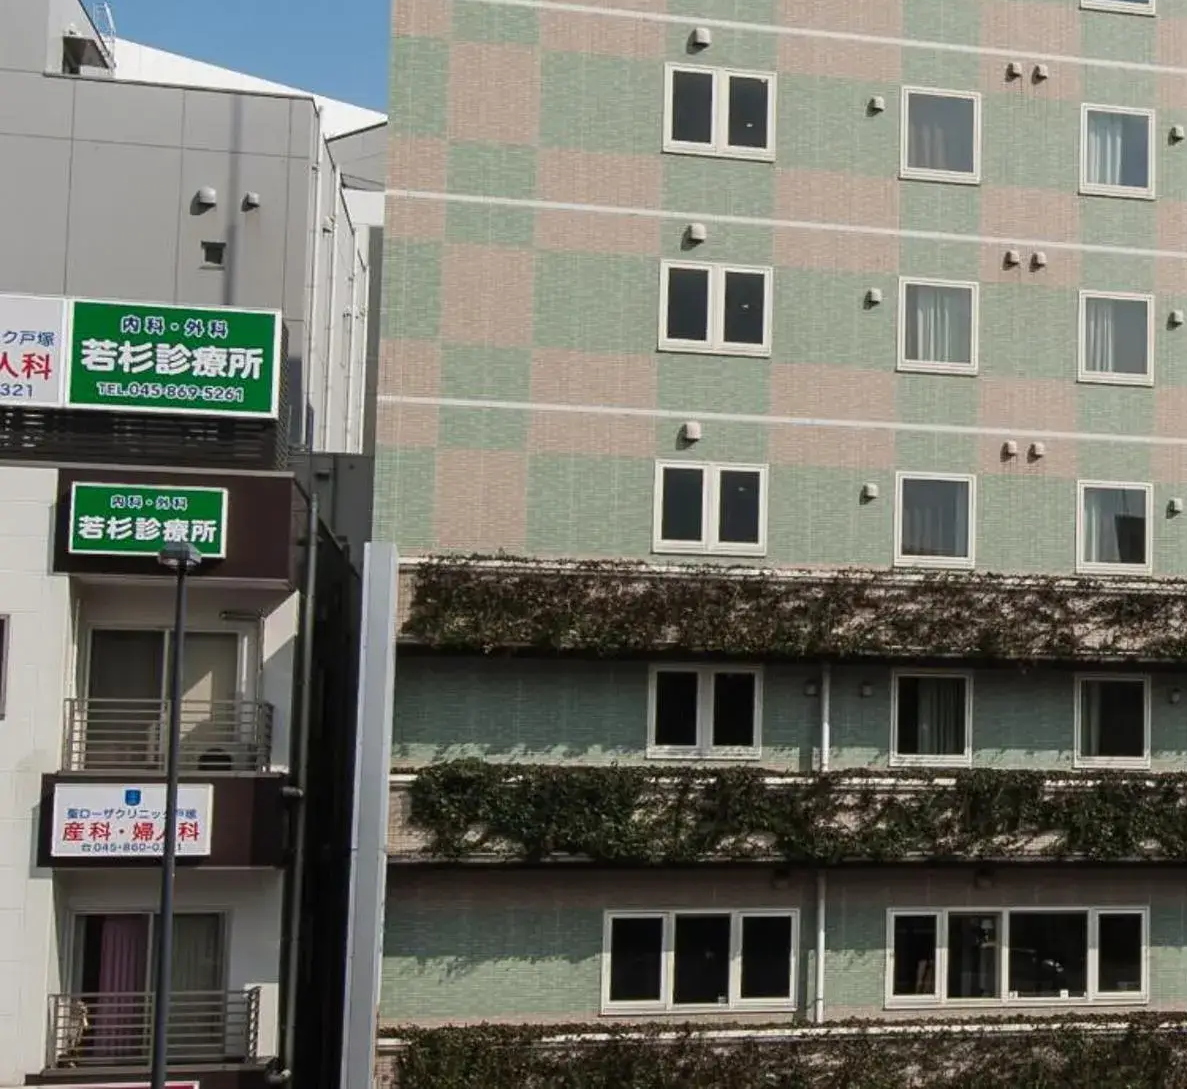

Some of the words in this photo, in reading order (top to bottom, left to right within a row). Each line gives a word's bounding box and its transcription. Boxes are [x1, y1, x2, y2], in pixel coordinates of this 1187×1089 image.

[121, 314, 229, 339] 内科・外科
[81, 338, 264, 380] 若杉診療所
[110, 494, 188, 511] 内科・外科
[78, 515, 217, 543] 若杉診療所
